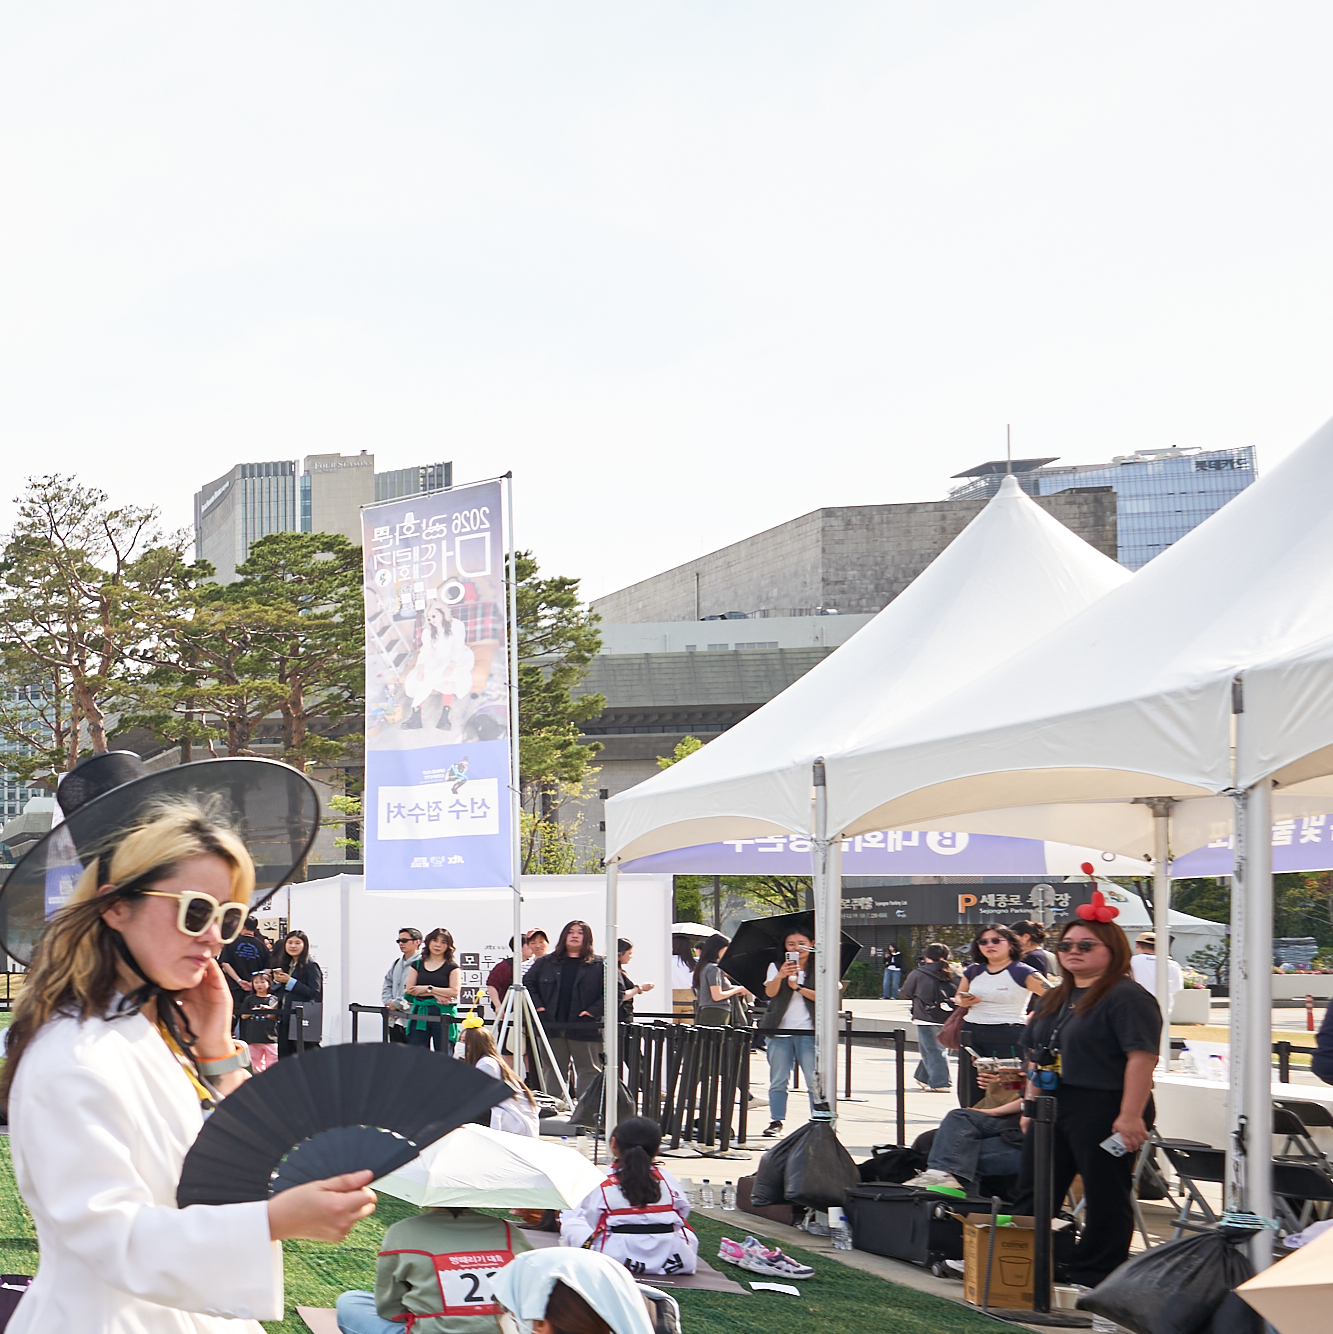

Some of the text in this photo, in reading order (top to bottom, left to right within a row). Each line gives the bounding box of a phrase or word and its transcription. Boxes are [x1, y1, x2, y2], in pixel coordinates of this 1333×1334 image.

[958, 893, 978, 914] P
[980, 893, 1023, 908] 세종로
[979, 907, 1009, 915] Sejongno
